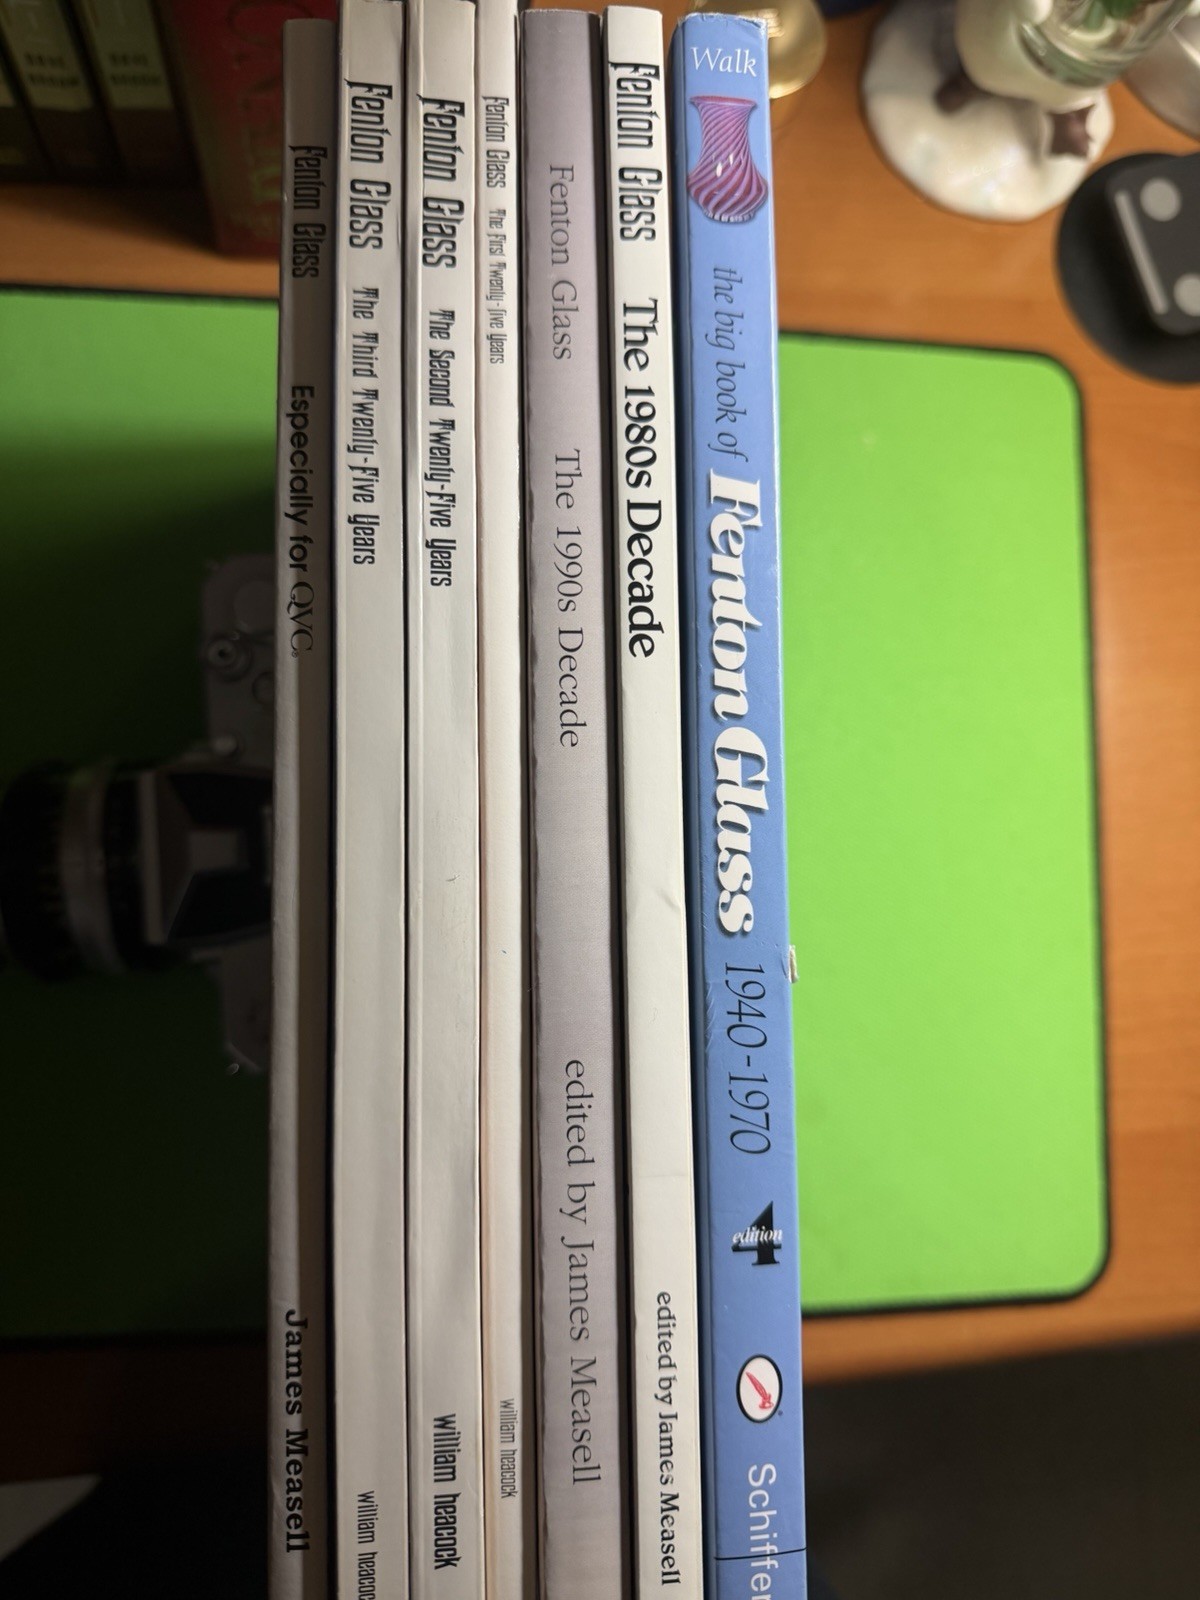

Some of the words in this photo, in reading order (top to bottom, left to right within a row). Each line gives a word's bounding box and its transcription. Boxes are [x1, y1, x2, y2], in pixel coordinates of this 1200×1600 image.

[690, 47, 757, 77] Walk
[344, 79, 393, 164] Fenton
[416, 93, 466, 182] Fenton
[482, 95, 510, 143] Fenton
[608, 62, 661, 150] Fenton
[288, 145, 329, 210] Fenton
[486, 150, 511, 189] Glass
[618, 166, 663, 243] Glass
[349, 178, 391, 250] Glass
[422, 196, 465, 269] Glass
[489, 209, 507, 230] The
[489, 234, 507, 257] First
[549, 164, 576, 267] Fenton
[292, 222, 326, 279] Glass
[712, 264, 745, 304] the
[353, 287, 379, 320] The
[429, 309, 456, 340] The
[551, 279, 579, 360] Glass
[623, 297, 659, 372] The
[705, 308, 745, 352] big
[352, 331, 379, 379] Third
[428, 350, 456, 408] Second
[715, 359, 748, 424] book
[284, 385, 315, 527] Especially
[347, 388, 380, 504] Twenty-Five
[624, 385, 657, 489] 1980s
[708, 432, 749, 463] of
[424, 418, 457, 528] Twenty-Five
[555, 448, 583, 510] The
[288, 534, 315, 573] for
[348, 514, 381, 566] Years
[425, 539, 457, 587] Years
[553, 526, 583, 612] 1990s
[627, 500, 664, 658] Decade
[709, 467, 764, 721] Fenton
[558, 626, 588, 748] Decade
[714, 726, 770, 934] Glass
[564, 1059, 595, 1167] edited
[559, 1180, 596, 1225] by
[731, 1200, 783, 1266] 4
[732, 1225, 784, 1244] edition
[560, 1236, 596, 1342] James
[284, 1309, 309, 1416] James
[656, 1291, 677, 1371] edited
[500, 1398, 519, 1443] william
[570, 1356, 601, 1486] Measell
[654, 1375, 678, 1406] by
[433, 1413, 461, 1484] william
[500, 1448, 519, 1499] heacock
[658, 1411, 679, 1486] James
[285, 1428, 310, 1554] Measell
[357, 1490, 379, 1545] william
[434, 1492, 462, 1571] heacock
[660, 1492, 681, 1586] Measell
[358, 1551, 379, 1600] heacoc
